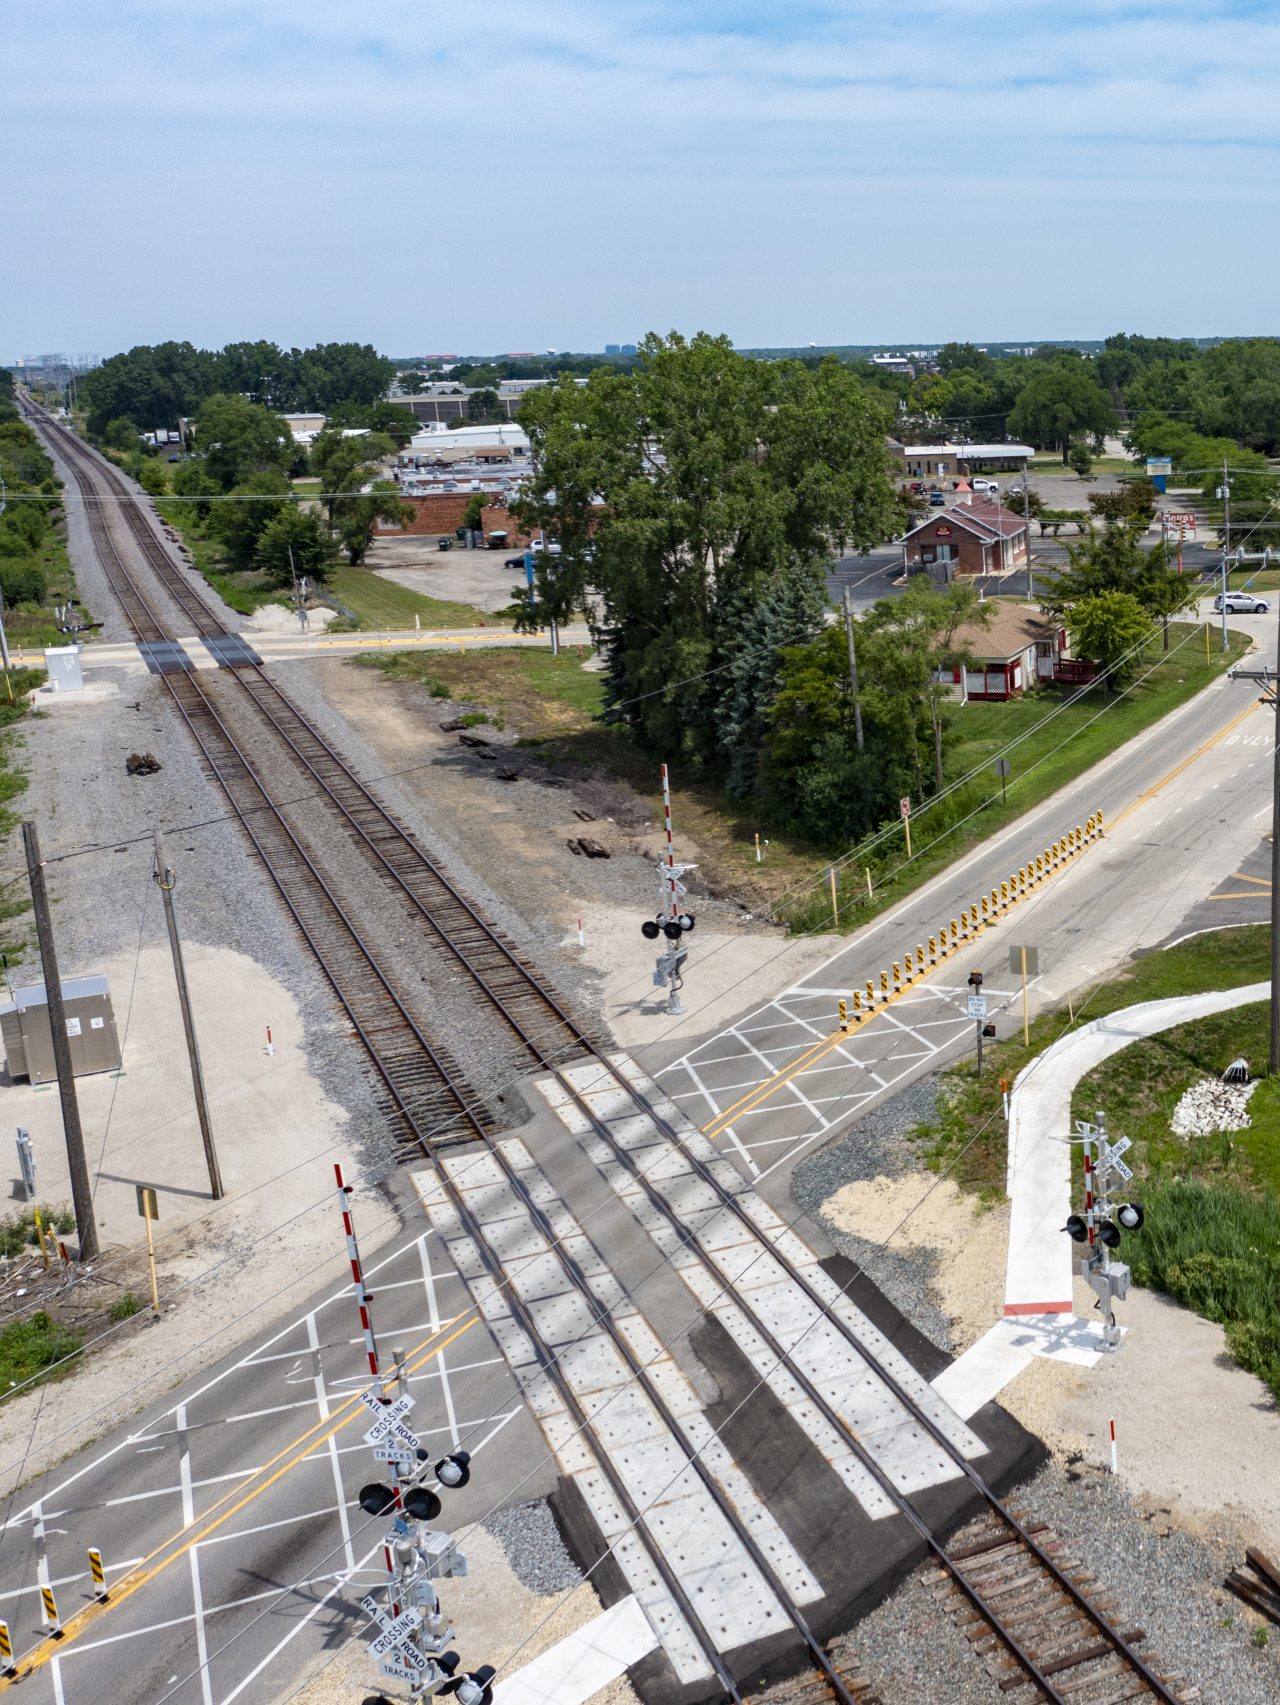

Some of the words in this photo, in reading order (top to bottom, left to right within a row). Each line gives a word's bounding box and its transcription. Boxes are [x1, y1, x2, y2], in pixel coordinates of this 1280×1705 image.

[1225, 735, 1275, 746] ONLY
[1115, 1160, 1131, 1178] ROAD
[360, 1392, 381, 1415] RAIL
[395, 1425, 418, 1447] ROAD
[370, 1400, 409, 1439] CROSSING
[388, 1439, 395, 1449] 2
[375, 1451, 411, 1460] TRACKS
[362, 1598, 385, 1626] RAL
[400, 1640, 425, 1668] ROAD
[373, 1613, 415, 1654] CROSSING
[394, 1653, 401, 1664] 2
[383, 1664, 416, 1681] TRACKS
